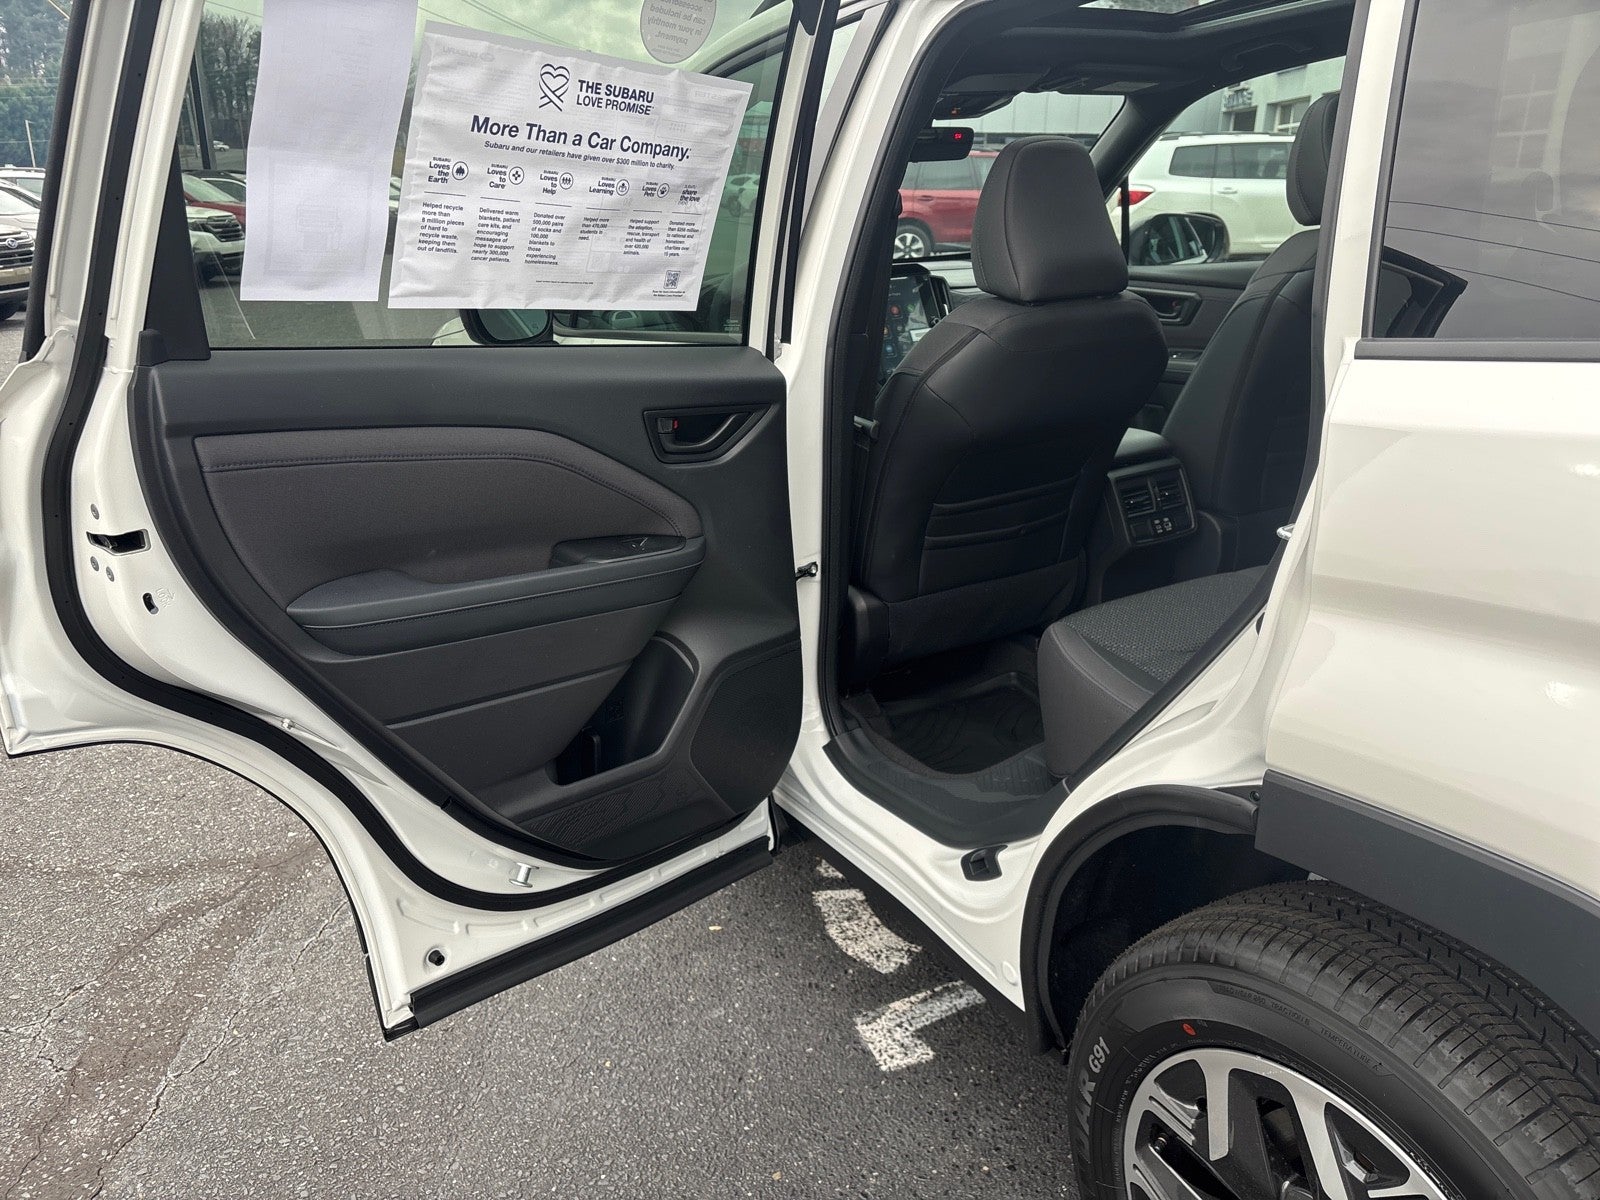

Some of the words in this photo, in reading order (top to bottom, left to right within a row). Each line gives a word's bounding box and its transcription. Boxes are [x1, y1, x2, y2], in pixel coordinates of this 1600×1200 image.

[578, 79, 602, 95] THE
[604, 84, 654, 104] SUBARU
[576, 94, 603, 108] LOVE
[470, 115, 520, 138] More
[526, 122, 568, 144] Than
[572, 134, 583, 146] a
[588, 132, 616, 150] Car
[620, 136, 690, 162] Company.
[484, 140, 510, 151] Subaru
[538, 148, 566, 158] retailers
[583, 153, 600, 162] given
[630, 159, 648, 167] million
[656, 162, 674, 170] charity.
[429, 161, 450, 170] Loves
[487, 168, 507, 176] Loves
[428, 176, 448, 184] Earth
[540, 174, 558, 182] Loves
[489, 181, 506, 189] Care
[589, 186, 614, 196] Learning
[422, 202, 442, 210] Helped
[1320, 1027, 1371, 1064] TEMPERATURE
[1088, 1036, 1110, 1074] G91
